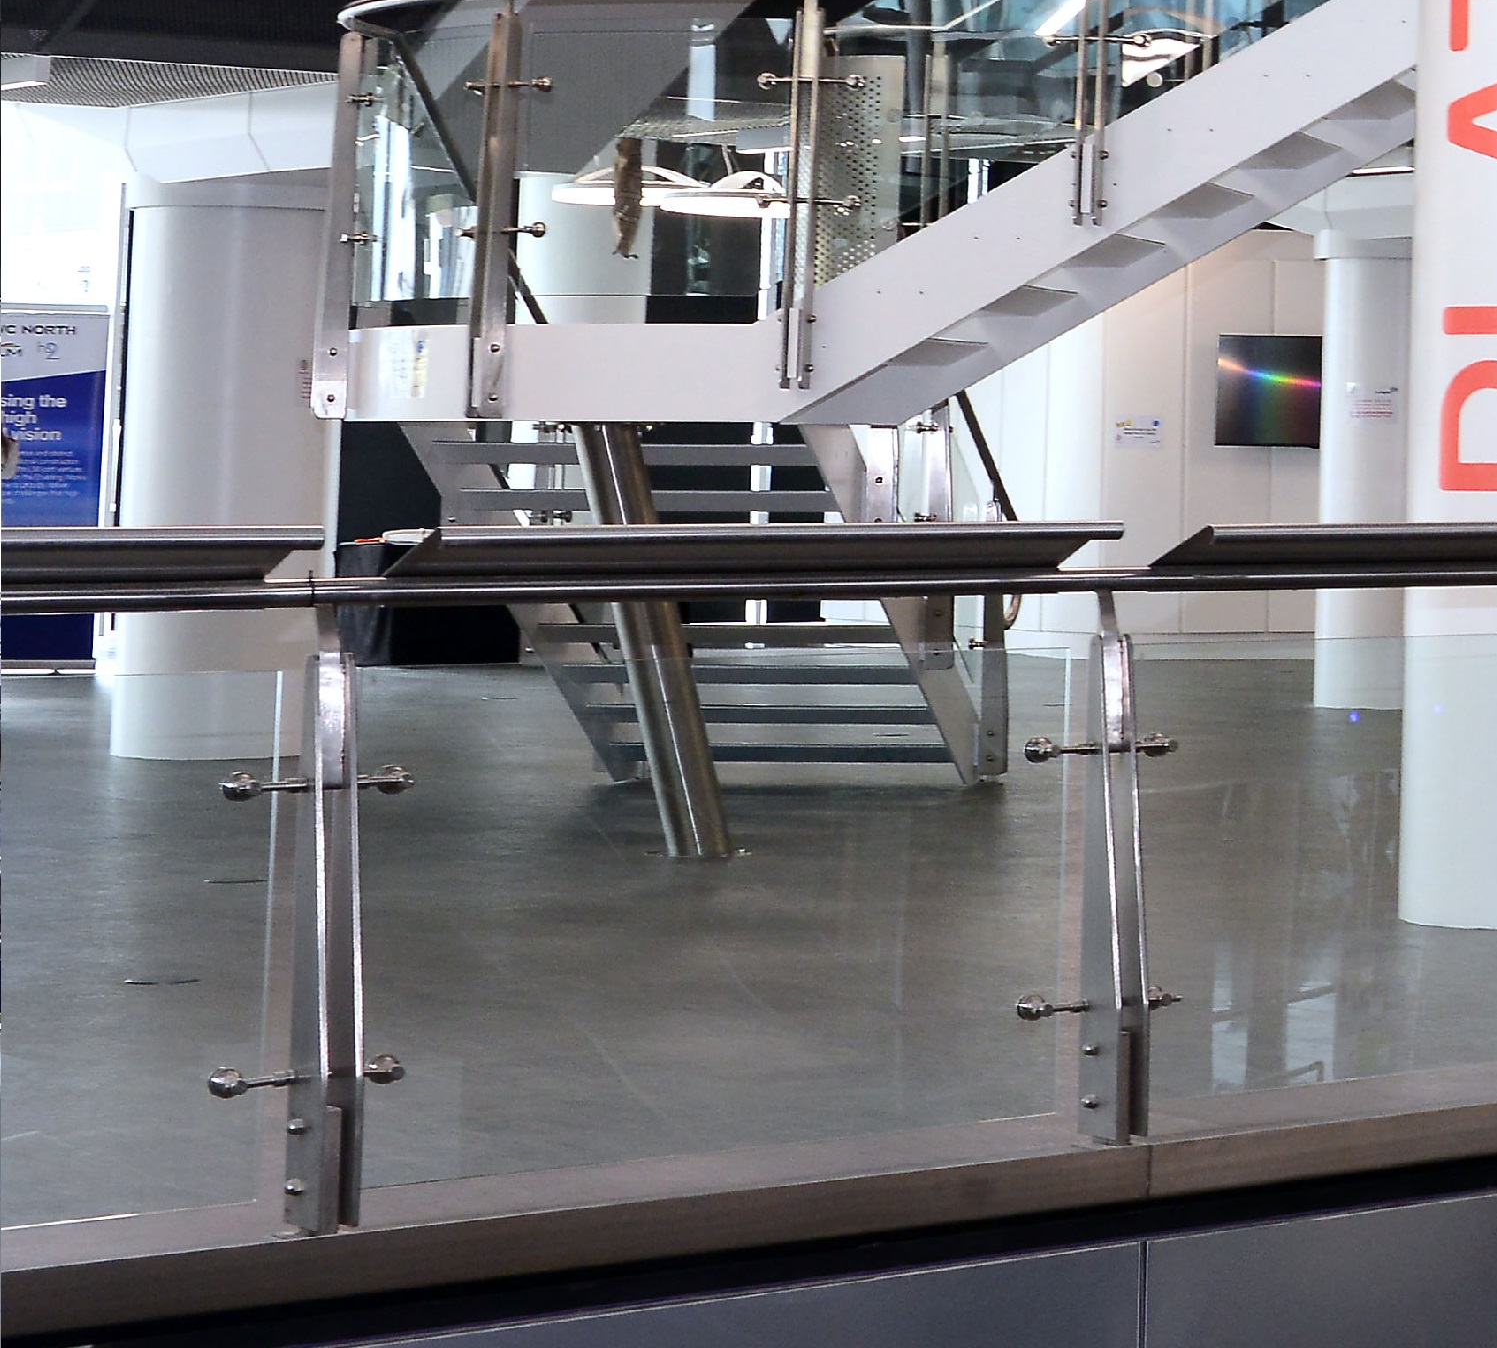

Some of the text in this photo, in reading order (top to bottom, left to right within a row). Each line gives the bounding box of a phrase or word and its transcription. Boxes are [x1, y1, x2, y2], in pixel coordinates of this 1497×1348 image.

[20, 324, 76, 335] NORTH
[37, 394, 67, 408] the
[11, 427, 62, 440] vision
